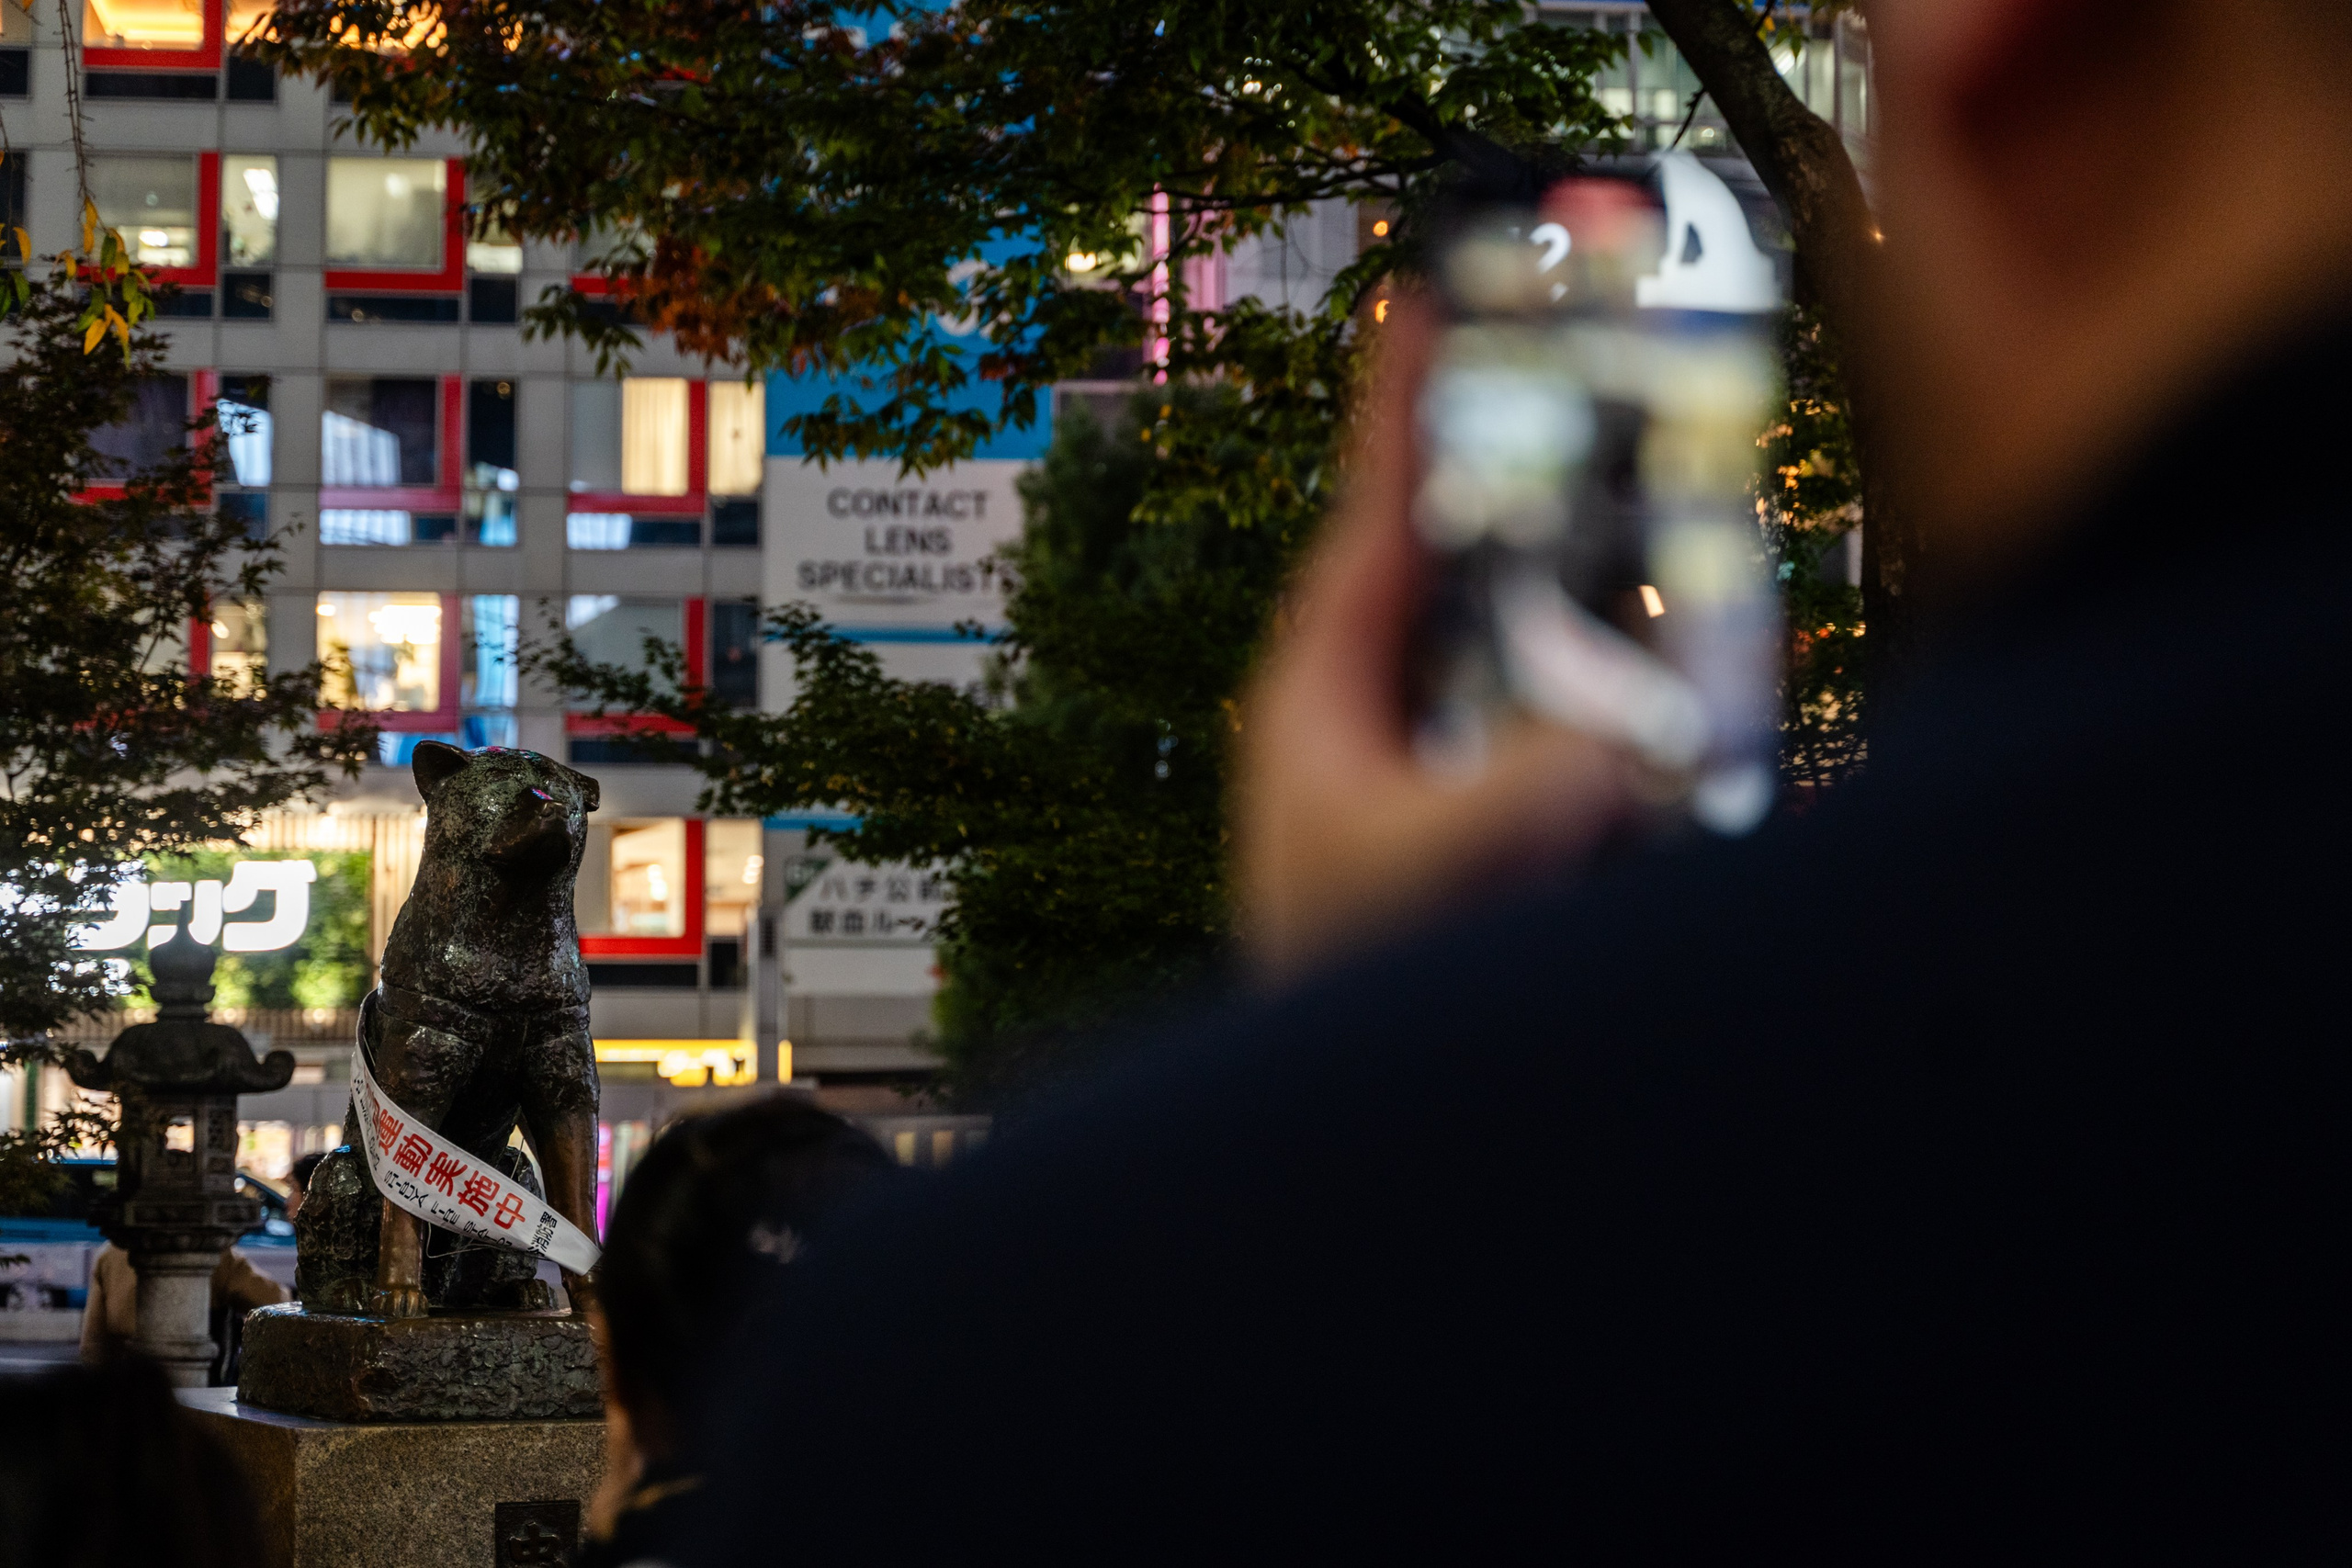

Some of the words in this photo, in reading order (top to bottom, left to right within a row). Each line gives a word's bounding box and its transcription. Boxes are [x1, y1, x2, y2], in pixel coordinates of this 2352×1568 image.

[828, 487, 989, 520] CONTACT
[864, 525, 952, 557] LENS
[384, 1170, 429, 1209] SHIBUYA
[430, 1201, 460, 1225] FIRE
